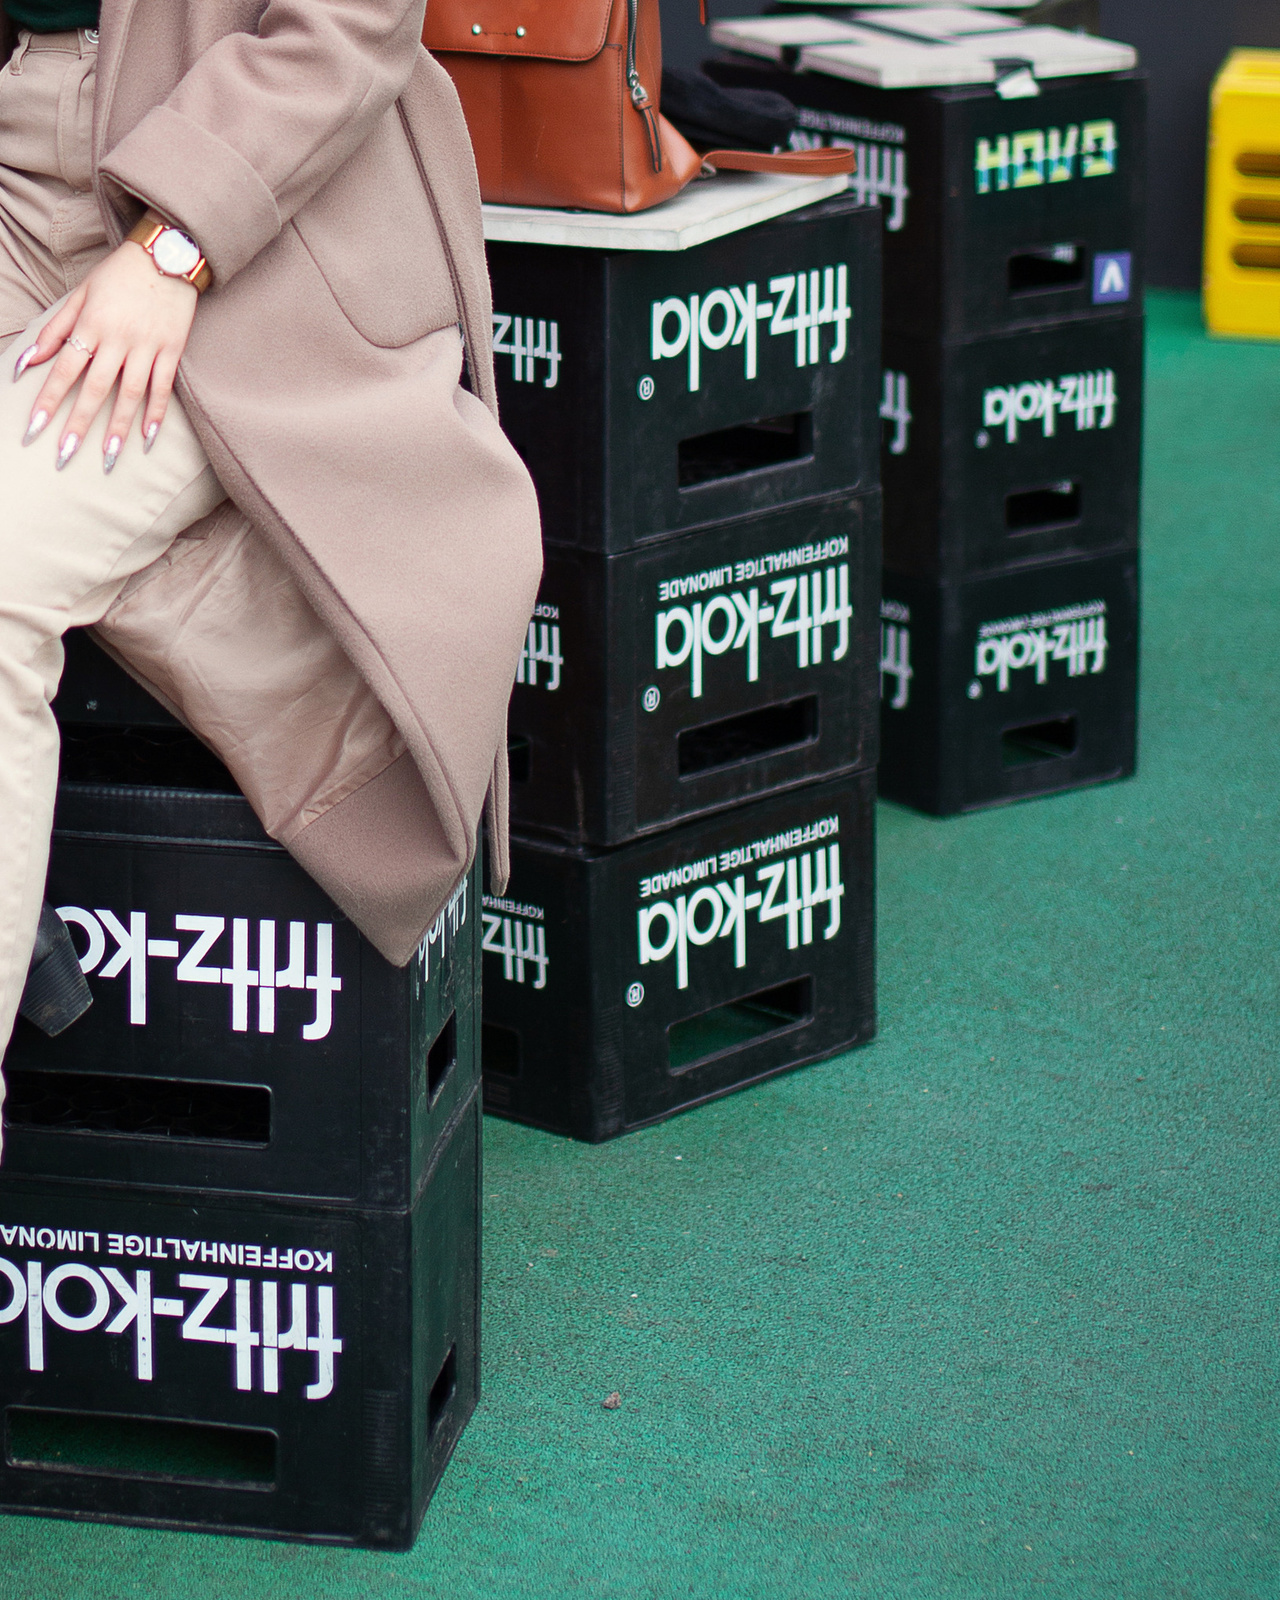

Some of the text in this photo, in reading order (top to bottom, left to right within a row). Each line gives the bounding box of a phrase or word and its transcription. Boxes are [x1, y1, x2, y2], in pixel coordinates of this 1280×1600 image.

[651, 264, 852, 393] fritz-kola
[982, 368, 1117, 443] fritz-kola
[658, 535, 849, 602] KOFFEINHALTIGE LIMONADE
[655, 563, 853, 698] fritz-kola
[975, 615, 1109, 692] fritz-kola
[639, 814, 839, 899] KOFFEINHALTIGE LIMONADE
[637, 843, 845, 990] fritz-kola
[108, 1232, 334, 1273] KOFFEINHALTIGE
